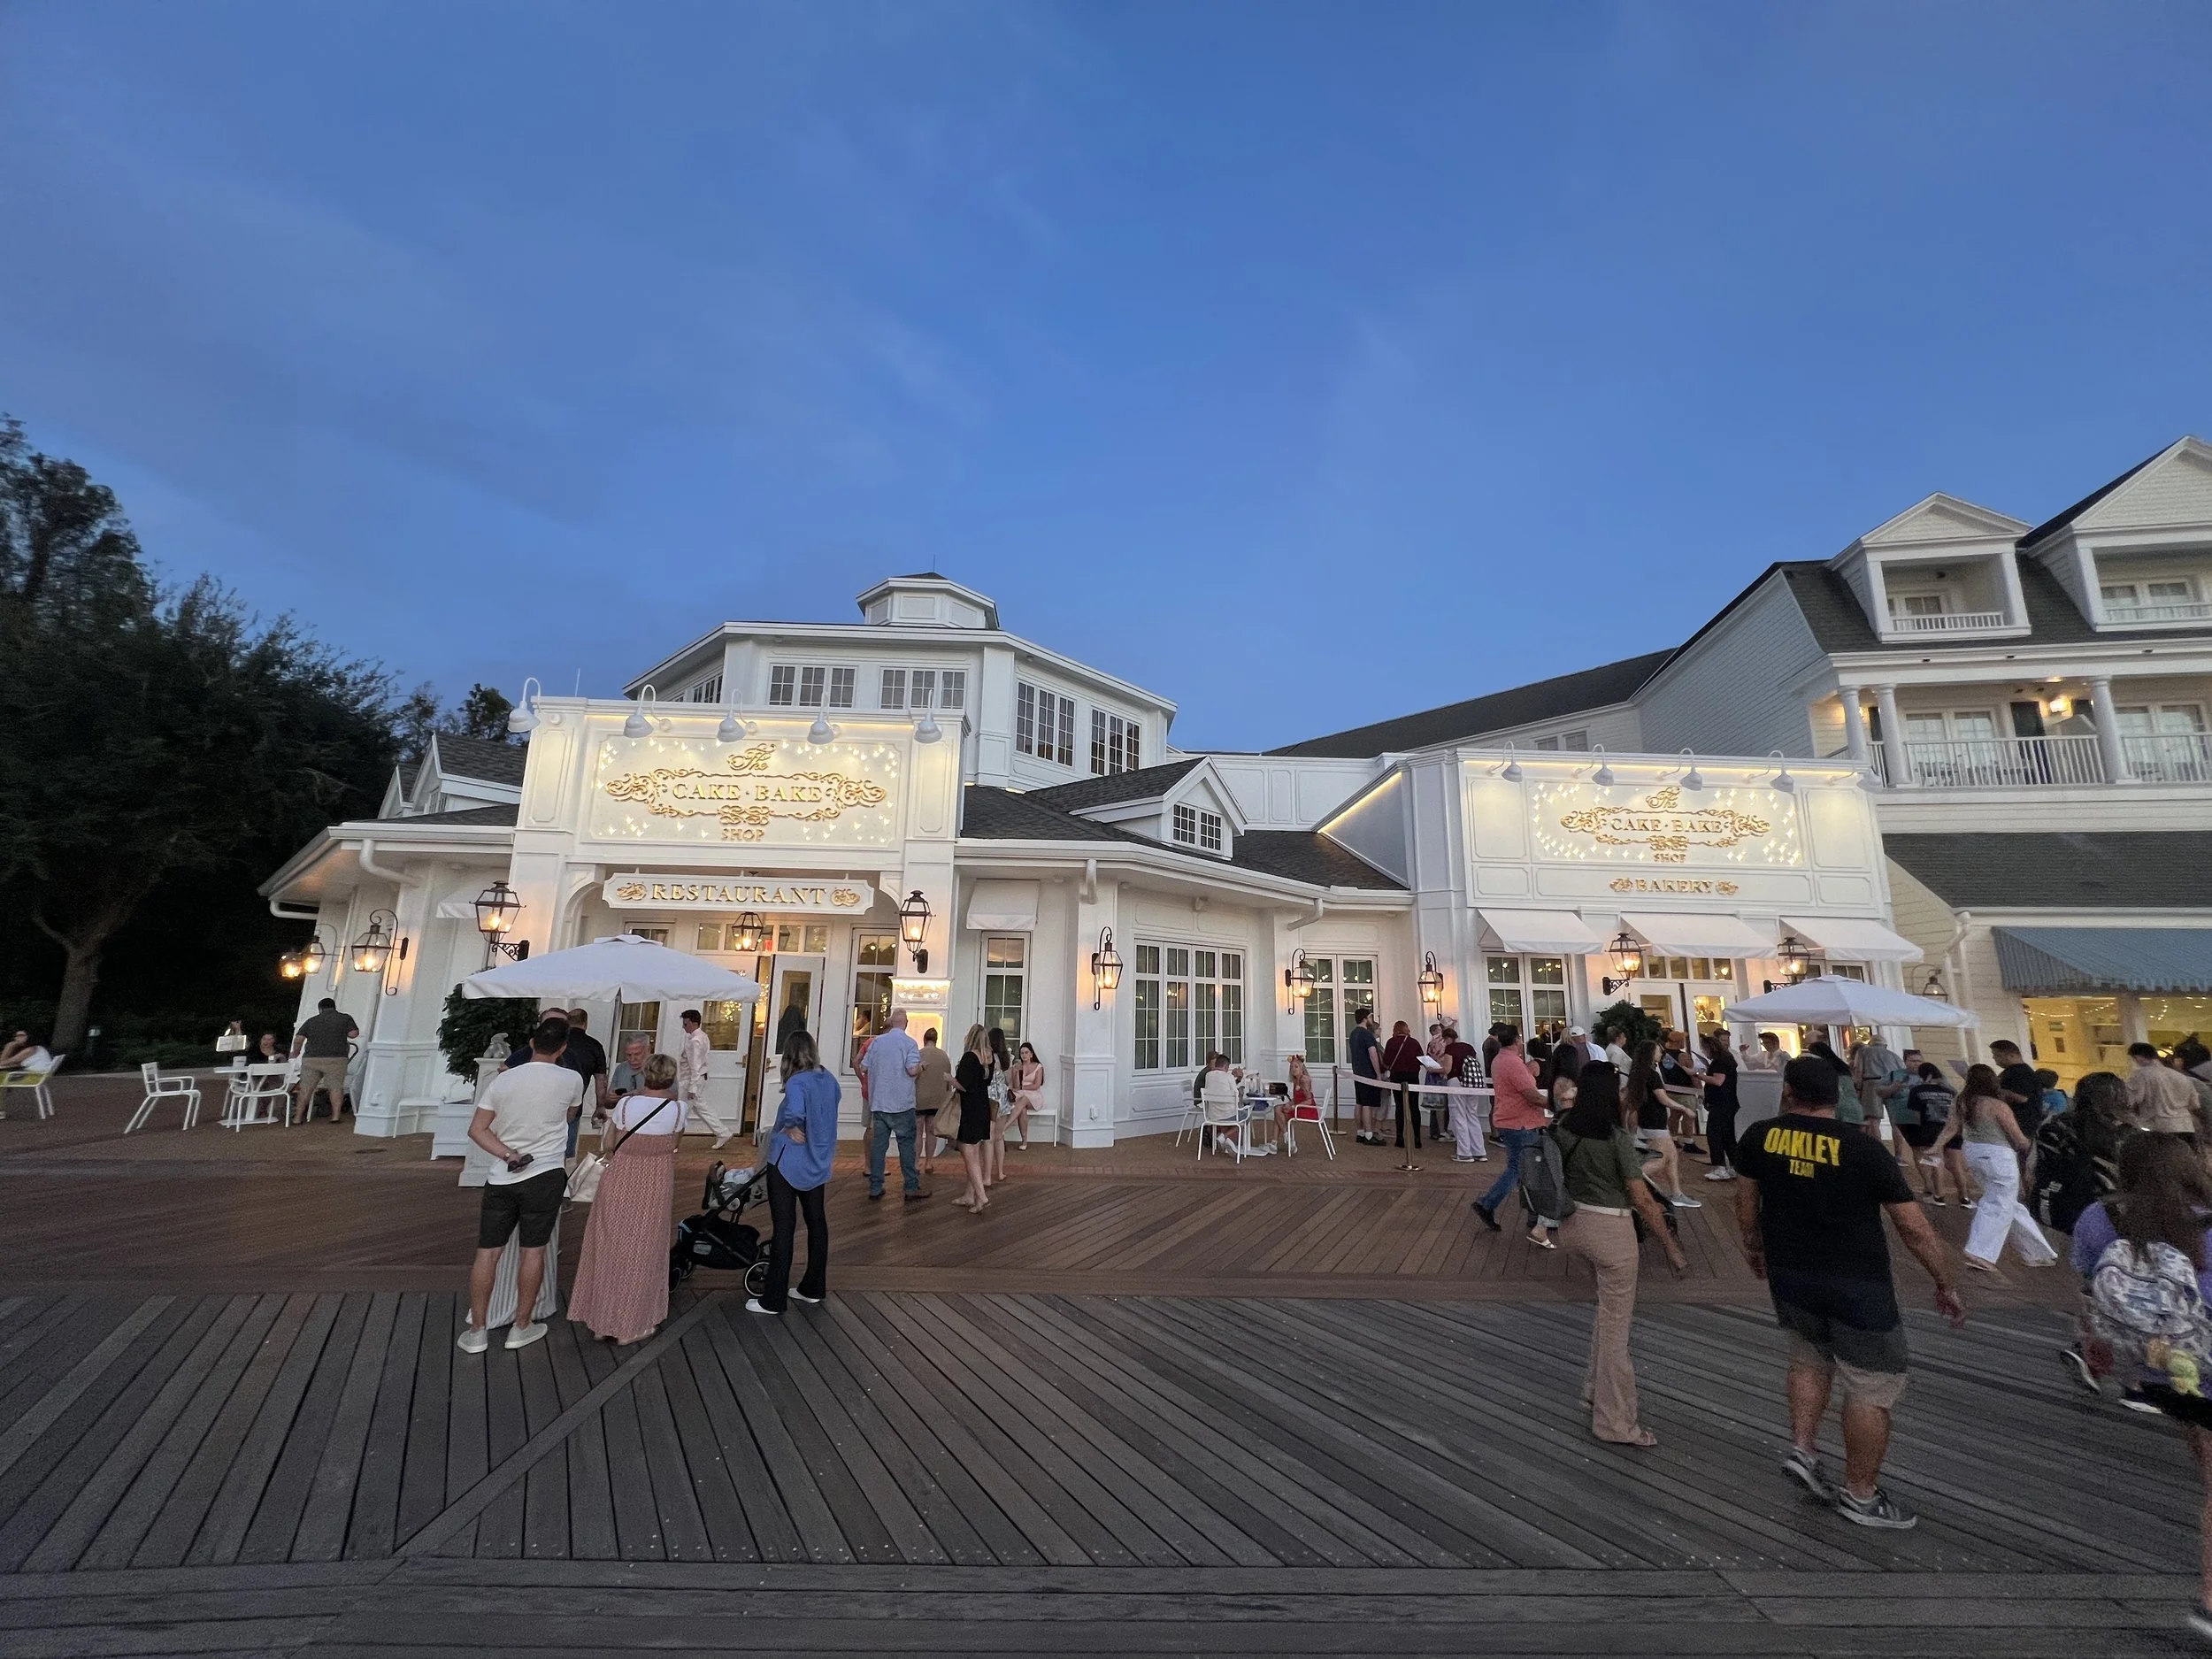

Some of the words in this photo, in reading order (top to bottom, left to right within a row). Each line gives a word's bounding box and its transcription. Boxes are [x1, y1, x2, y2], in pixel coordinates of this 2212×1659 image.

[726, 742, 777, 771] The
[672, 783, 741, 801] CAKE
[755, 785, 823, 803] BAKE
[1646, 787, 1680, 809] The
[721, 828, 765, 841] SHOP
[1611, 818, 1662, 831] CAKE
[1671, 820, 1723, 833] BAKE
[1653, 853, 1686, 864] SHOP
[651, 883, 827, 905] RESTAURANT
[1634, 878, 1714, 895] BAKERY
[1763, 1127, 1840, 1166] OAKLEY
[1789, 1159, 1815, 1179] TEAM
